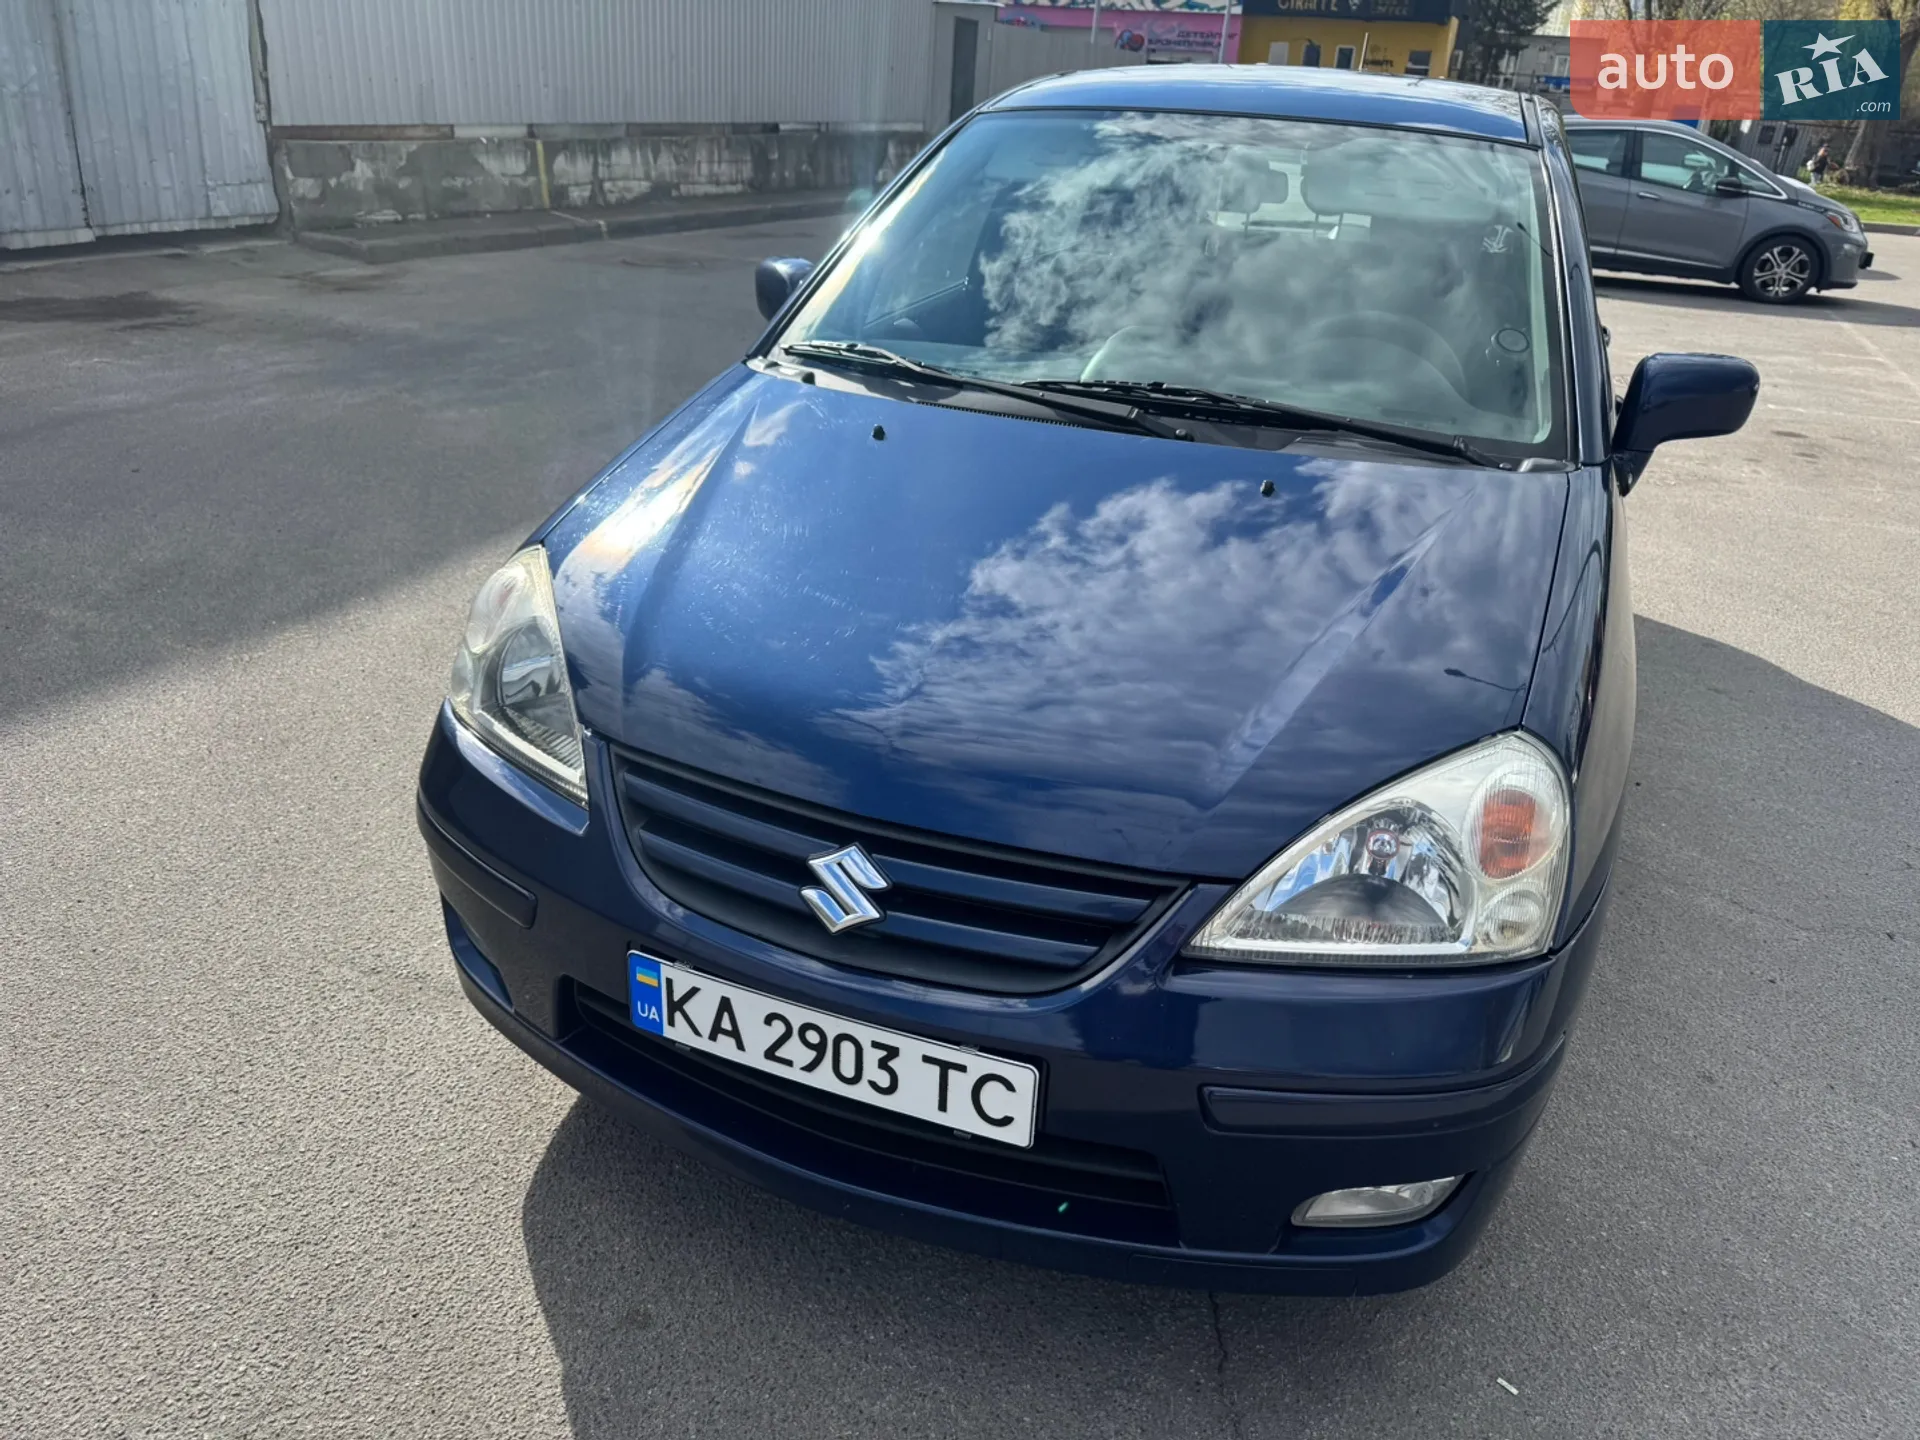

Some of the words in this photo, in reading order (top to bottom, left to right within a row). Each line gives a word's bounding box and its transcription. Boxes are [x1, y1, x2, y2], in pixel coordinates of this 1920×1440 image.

[637, 1000, 660, 1023] UA
[665, 977, 747, 1052] KA
[763, 1012, 900, 1096] 2903
[921, 1053, 1017, 1129] TC
